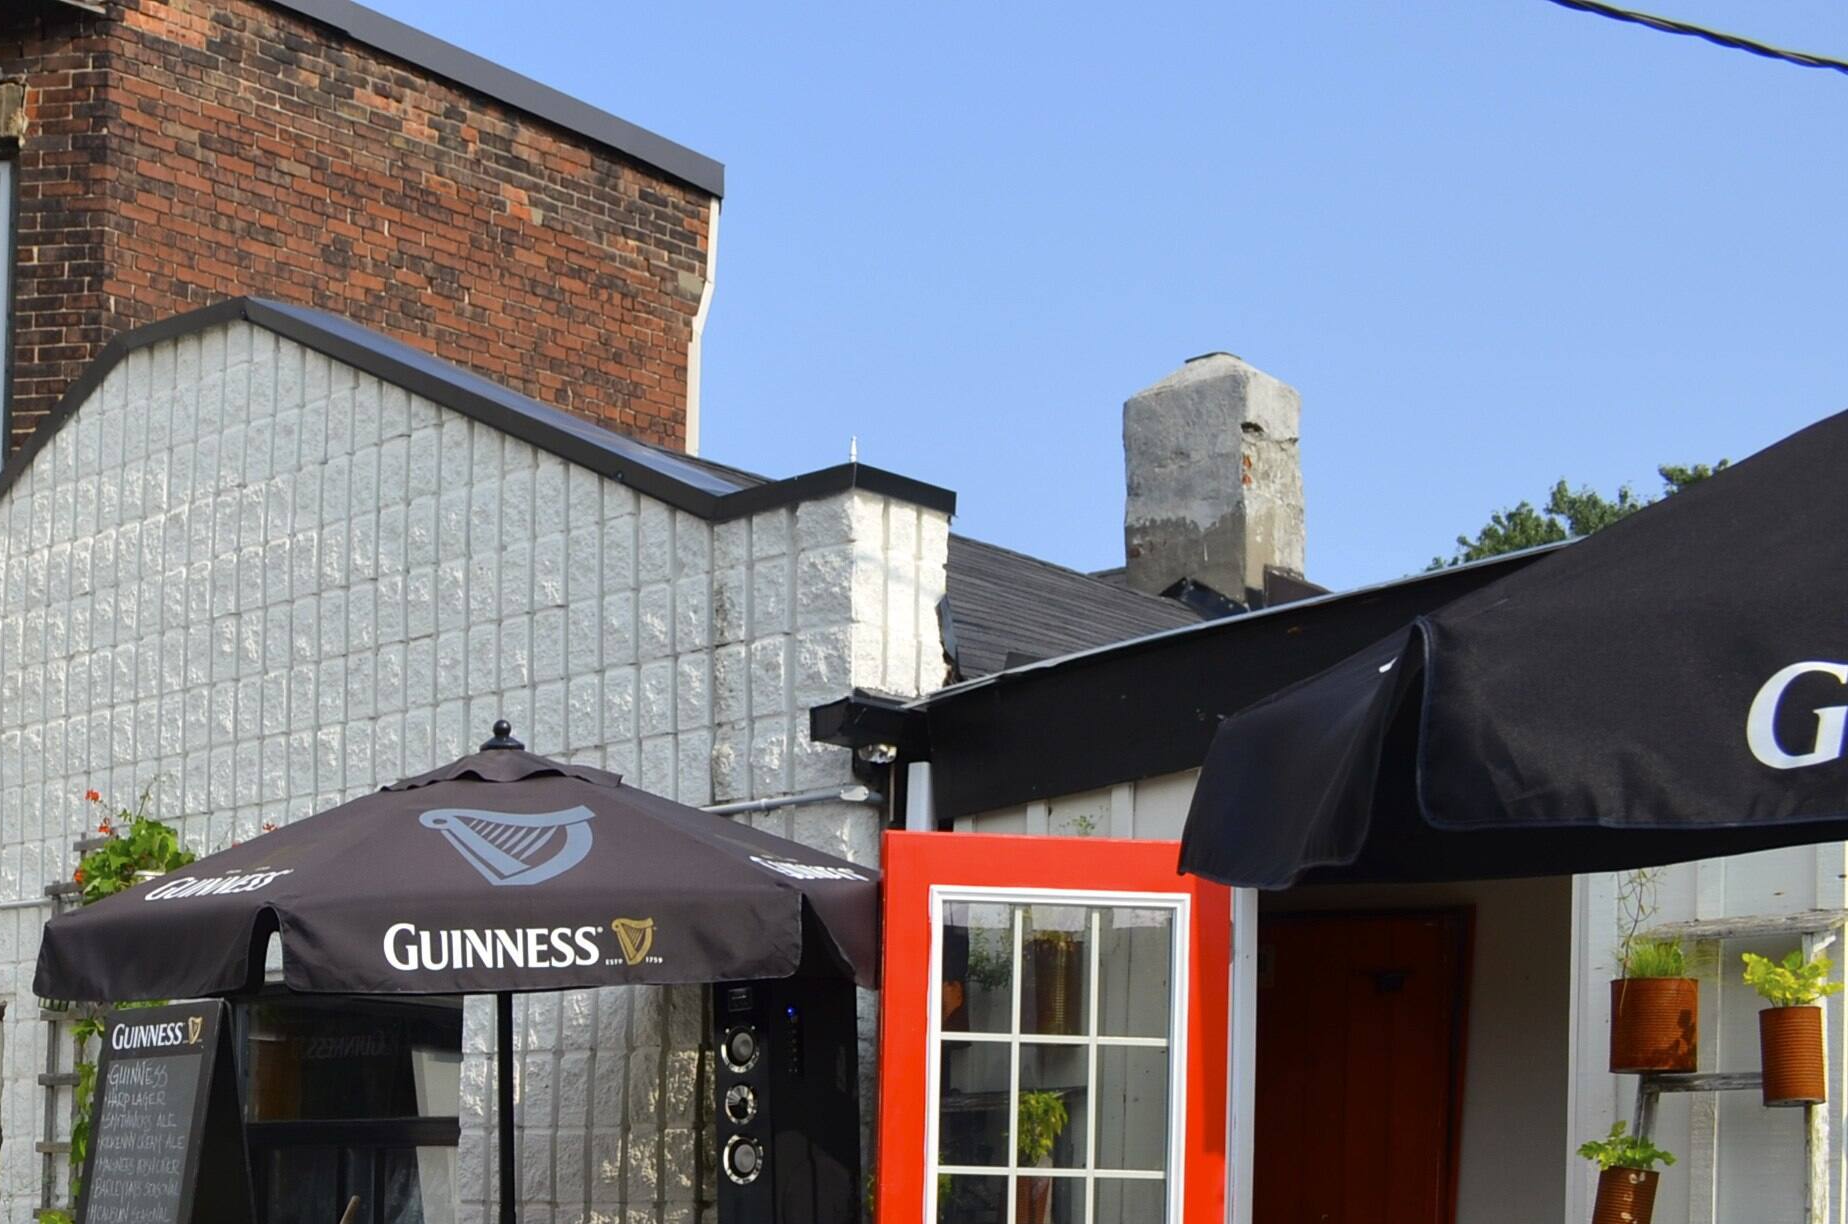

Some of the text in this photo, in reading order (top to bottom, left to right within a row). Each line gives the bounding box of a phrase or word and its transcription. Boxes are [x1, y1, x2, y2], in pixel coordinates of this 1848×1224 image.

[383, 923, 601, 970] GUINNESS
[112, 1022, 183, 1050] GUINNESS
[109, 1060, 168, 1089] GUINNESS
